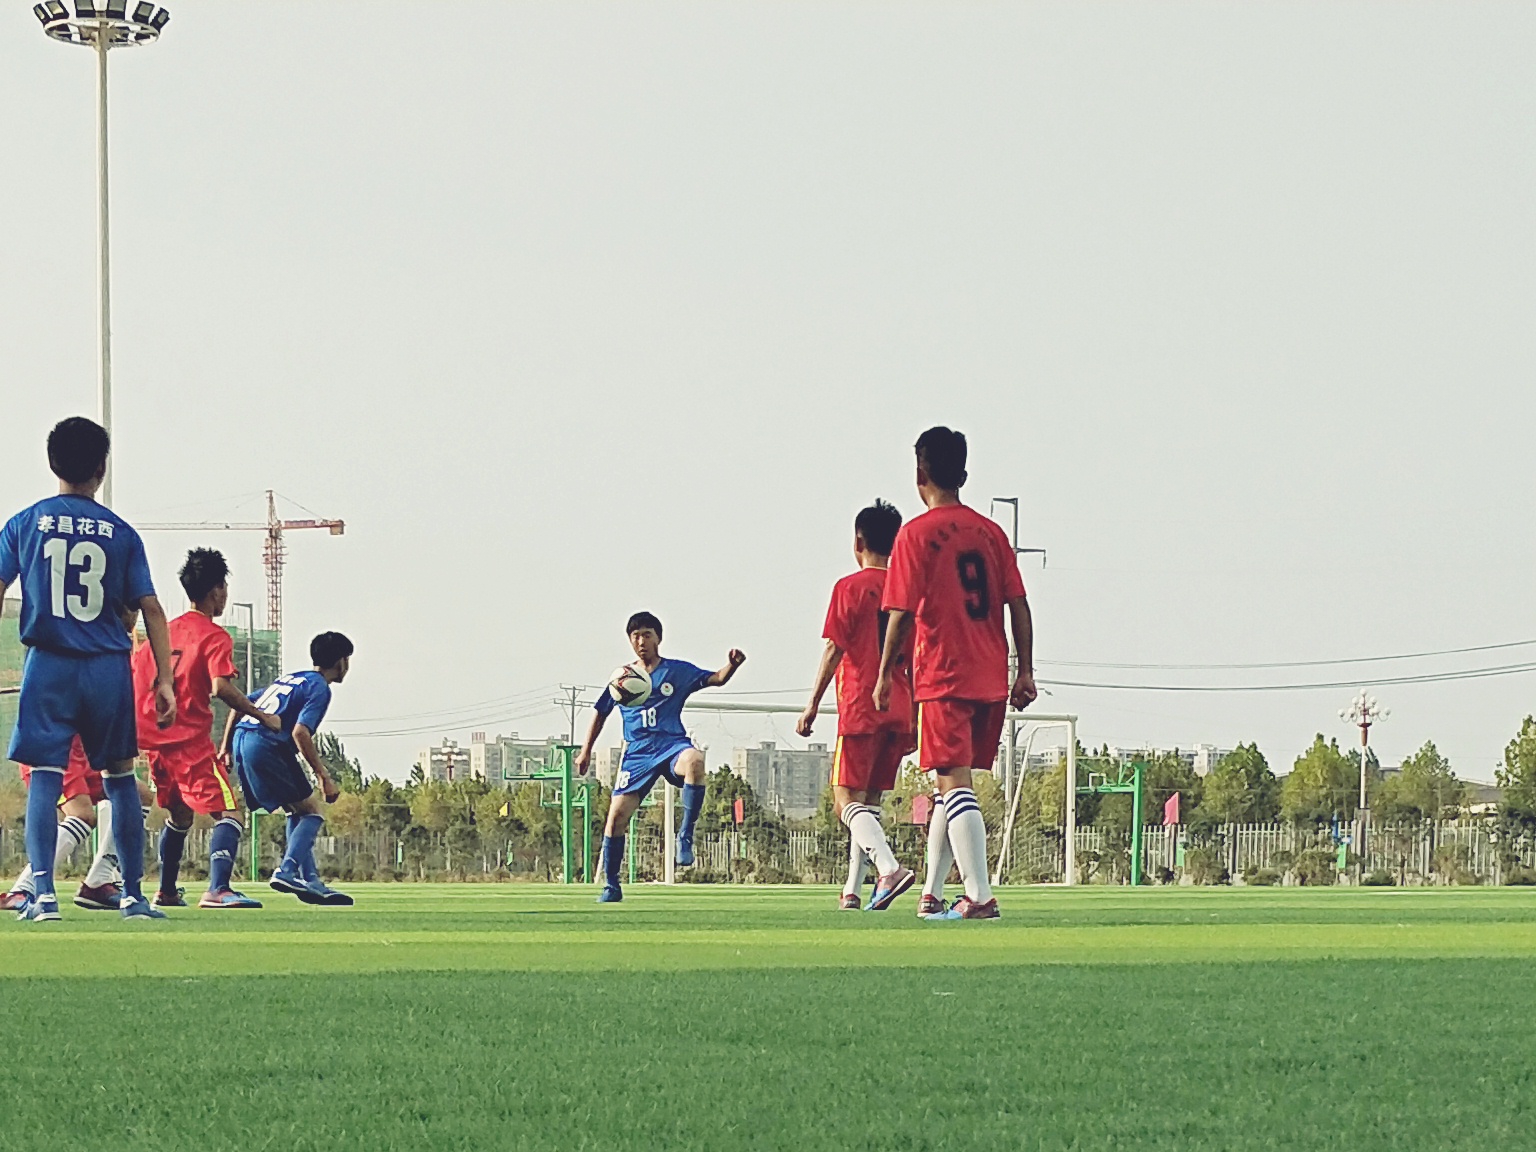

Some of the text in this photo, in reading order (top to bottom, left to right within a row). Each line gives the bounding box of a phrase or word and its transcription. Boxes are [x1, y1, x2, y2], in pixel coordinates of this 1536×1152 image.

[37, 515, 115, 539] 孝昌花西
[43, 537, 107, 622] 13
[958, 551, 988, 619] 9
[640, 707, 657, 728] 18
